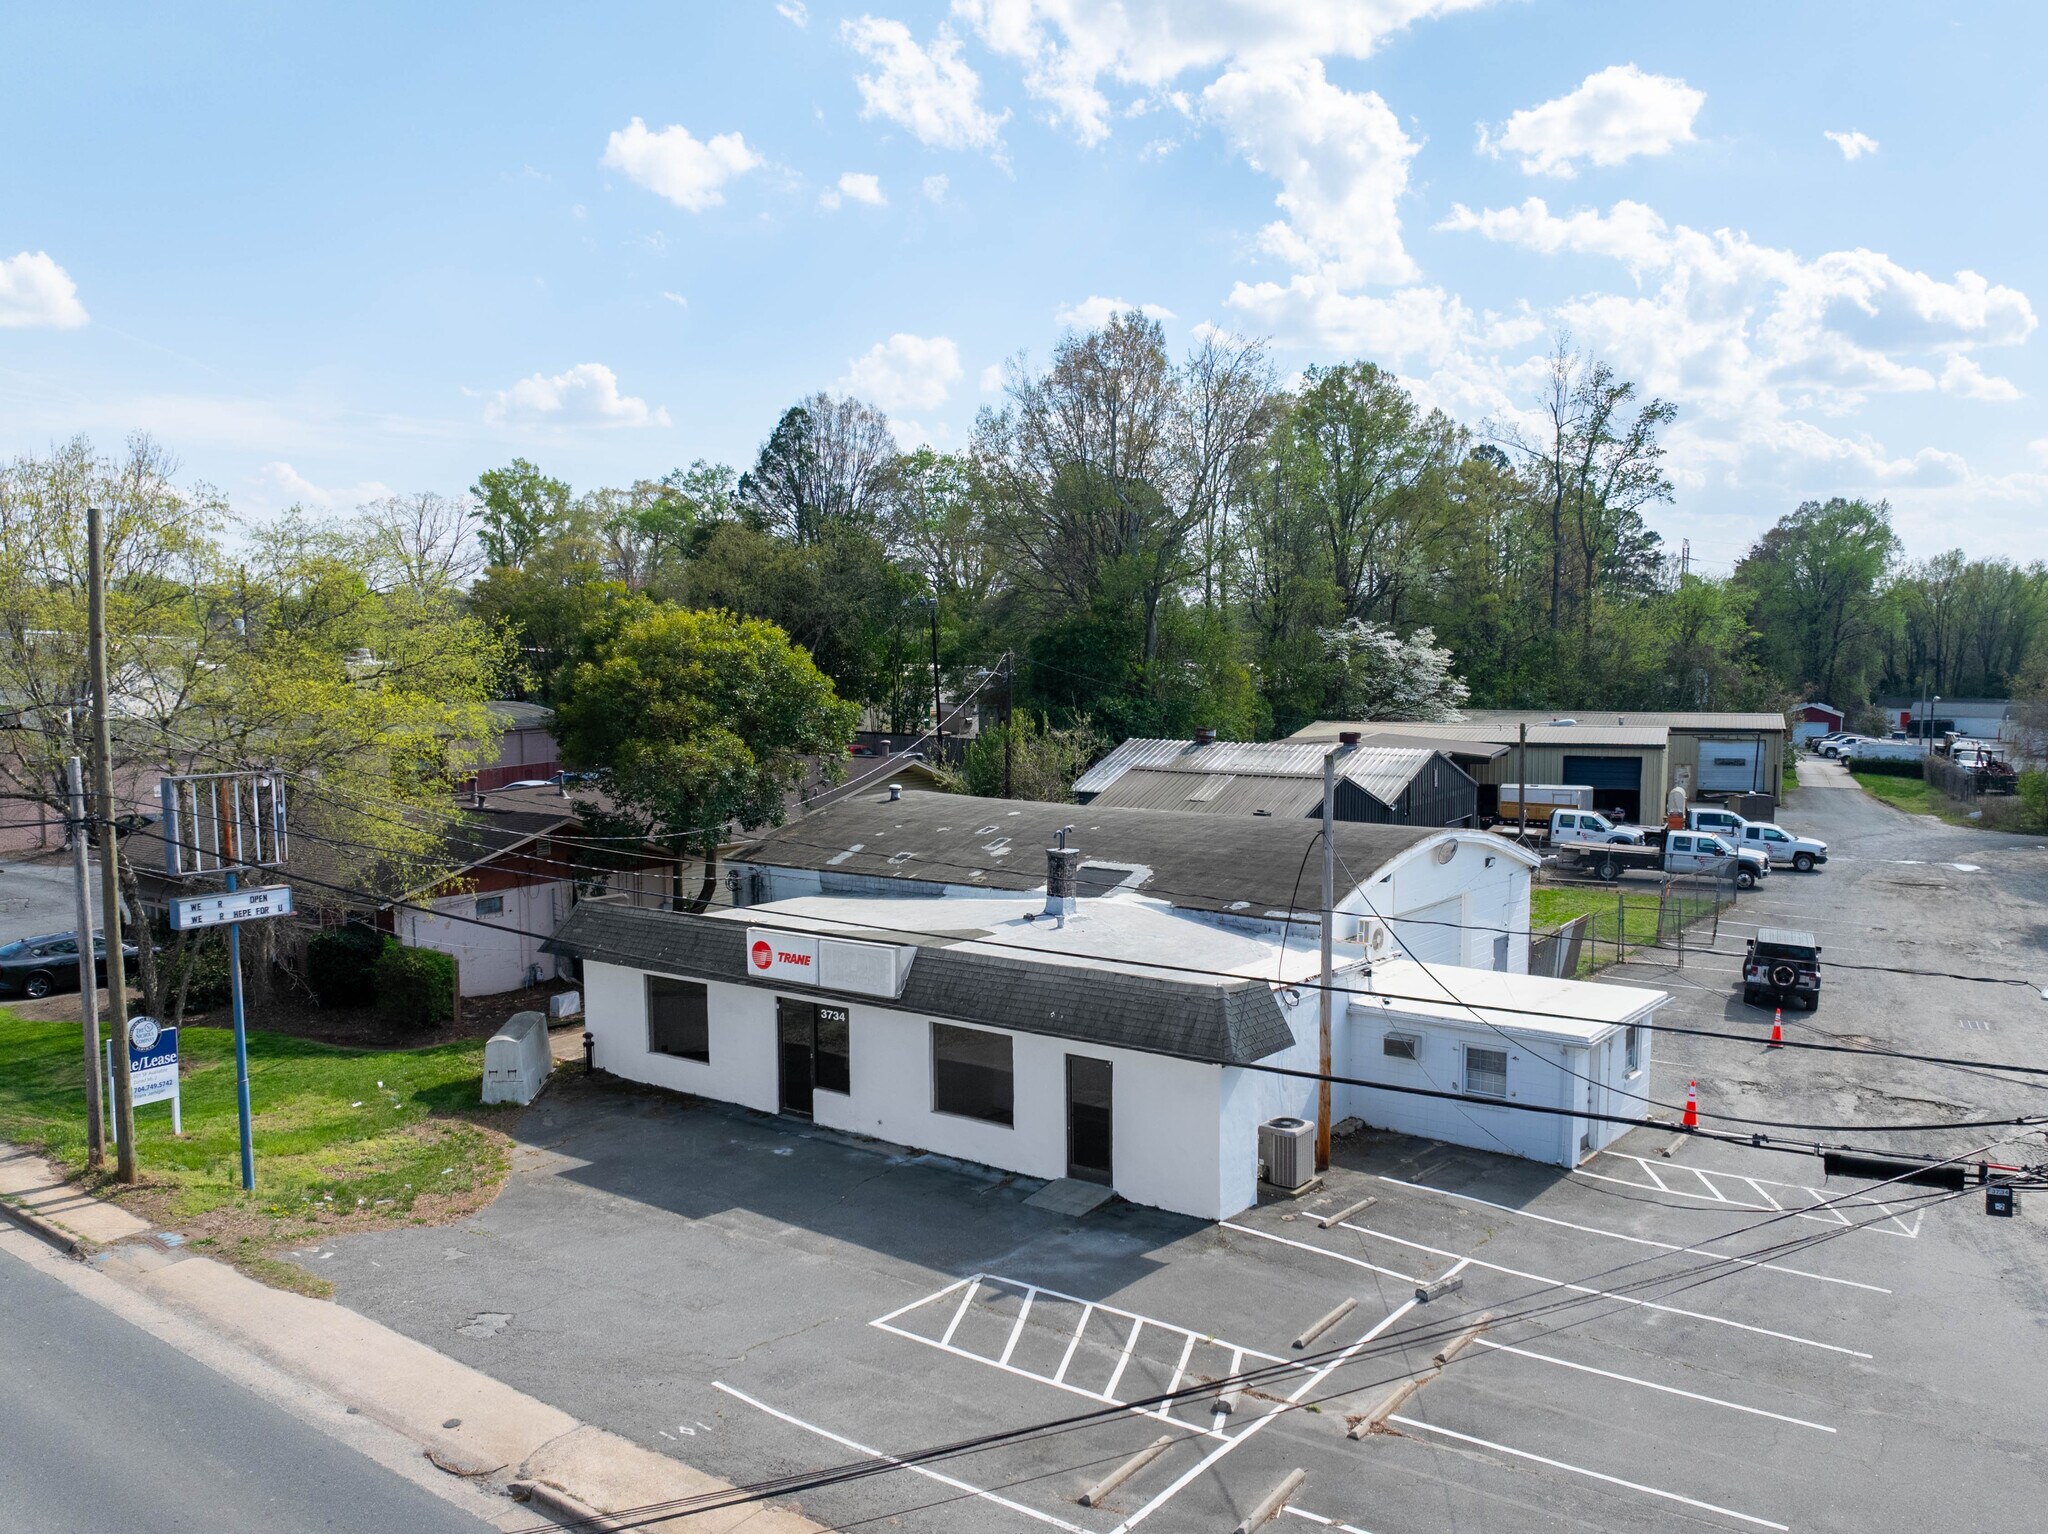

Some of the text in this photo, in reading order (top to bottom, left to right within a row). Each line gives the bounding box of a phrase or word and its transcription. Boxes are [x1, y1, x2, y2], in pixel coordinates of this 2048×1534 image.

[190, 894, 268, 912] WE R OPEN
[191, 915, 203, 924] WE
[219, 912, 224, 920] R
[256, 906, 270, 915] FOR
[278, 904, 283, 912] U
[777, 951, 812, 966] TRANE
[820, 1008, 846, 1022] 3734
[129, 1053, 177, 1071] e/Lease
[134, 1080, 173, 1093] 704.749.5742
